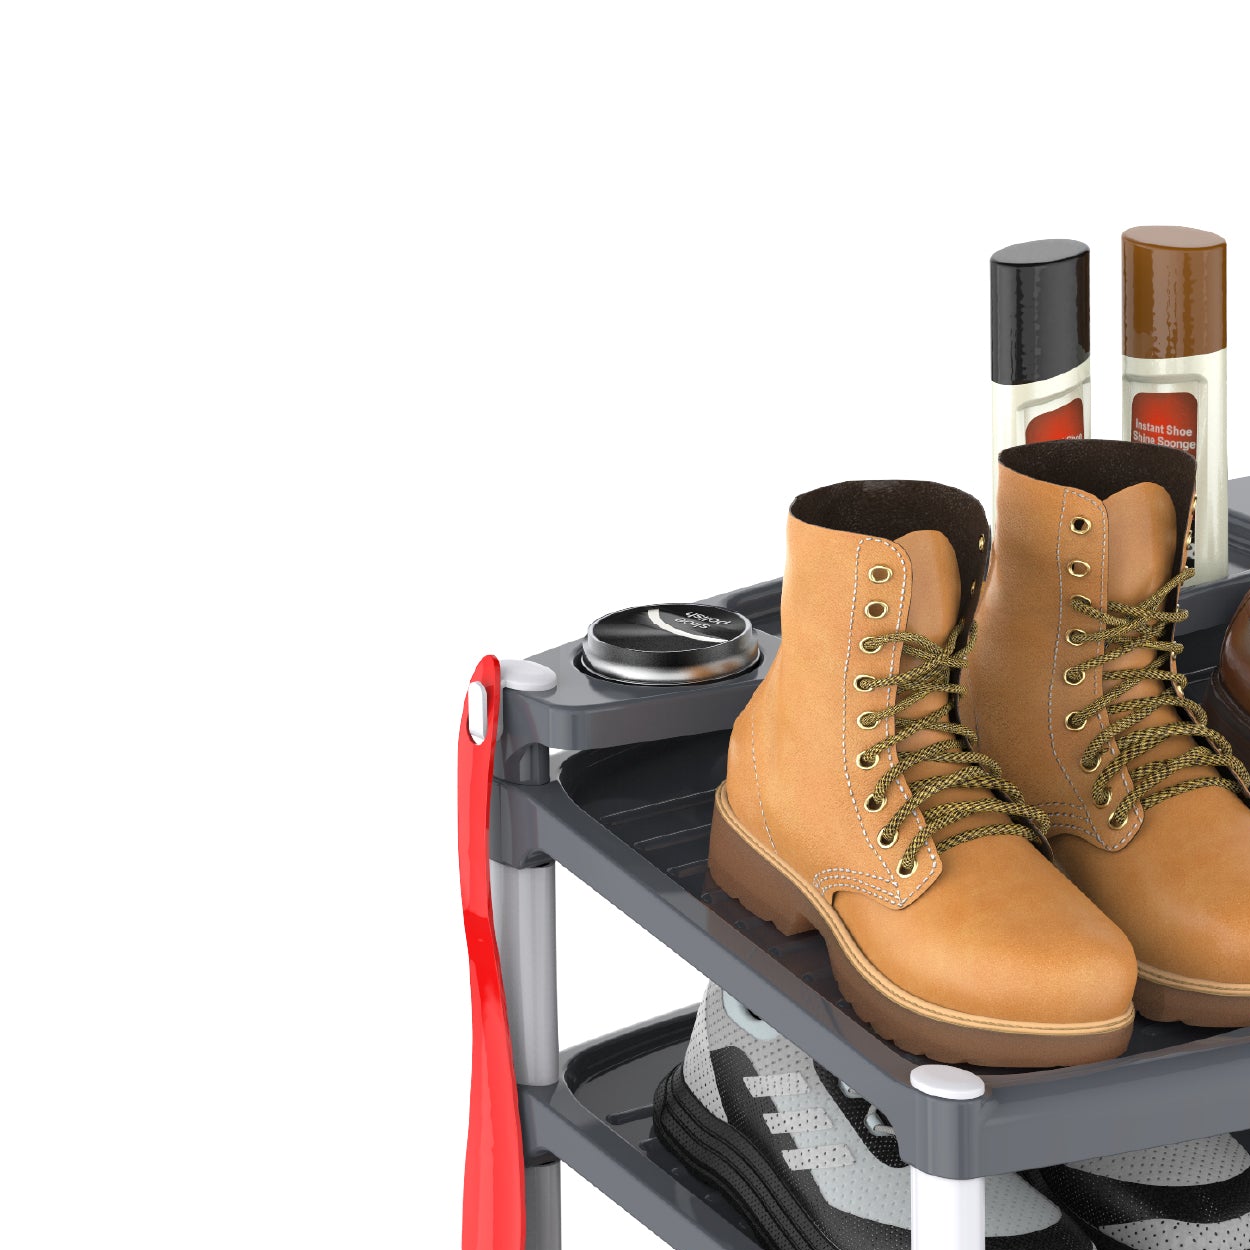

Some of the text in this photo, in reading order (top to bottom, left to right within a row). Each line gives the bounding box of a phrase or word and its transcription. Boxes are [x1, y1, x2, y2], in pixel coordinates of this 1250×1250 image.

[1136, 418, 1193, 436] Instant Shoe
[1133, 430, 1196, 451] Shine Sponge
